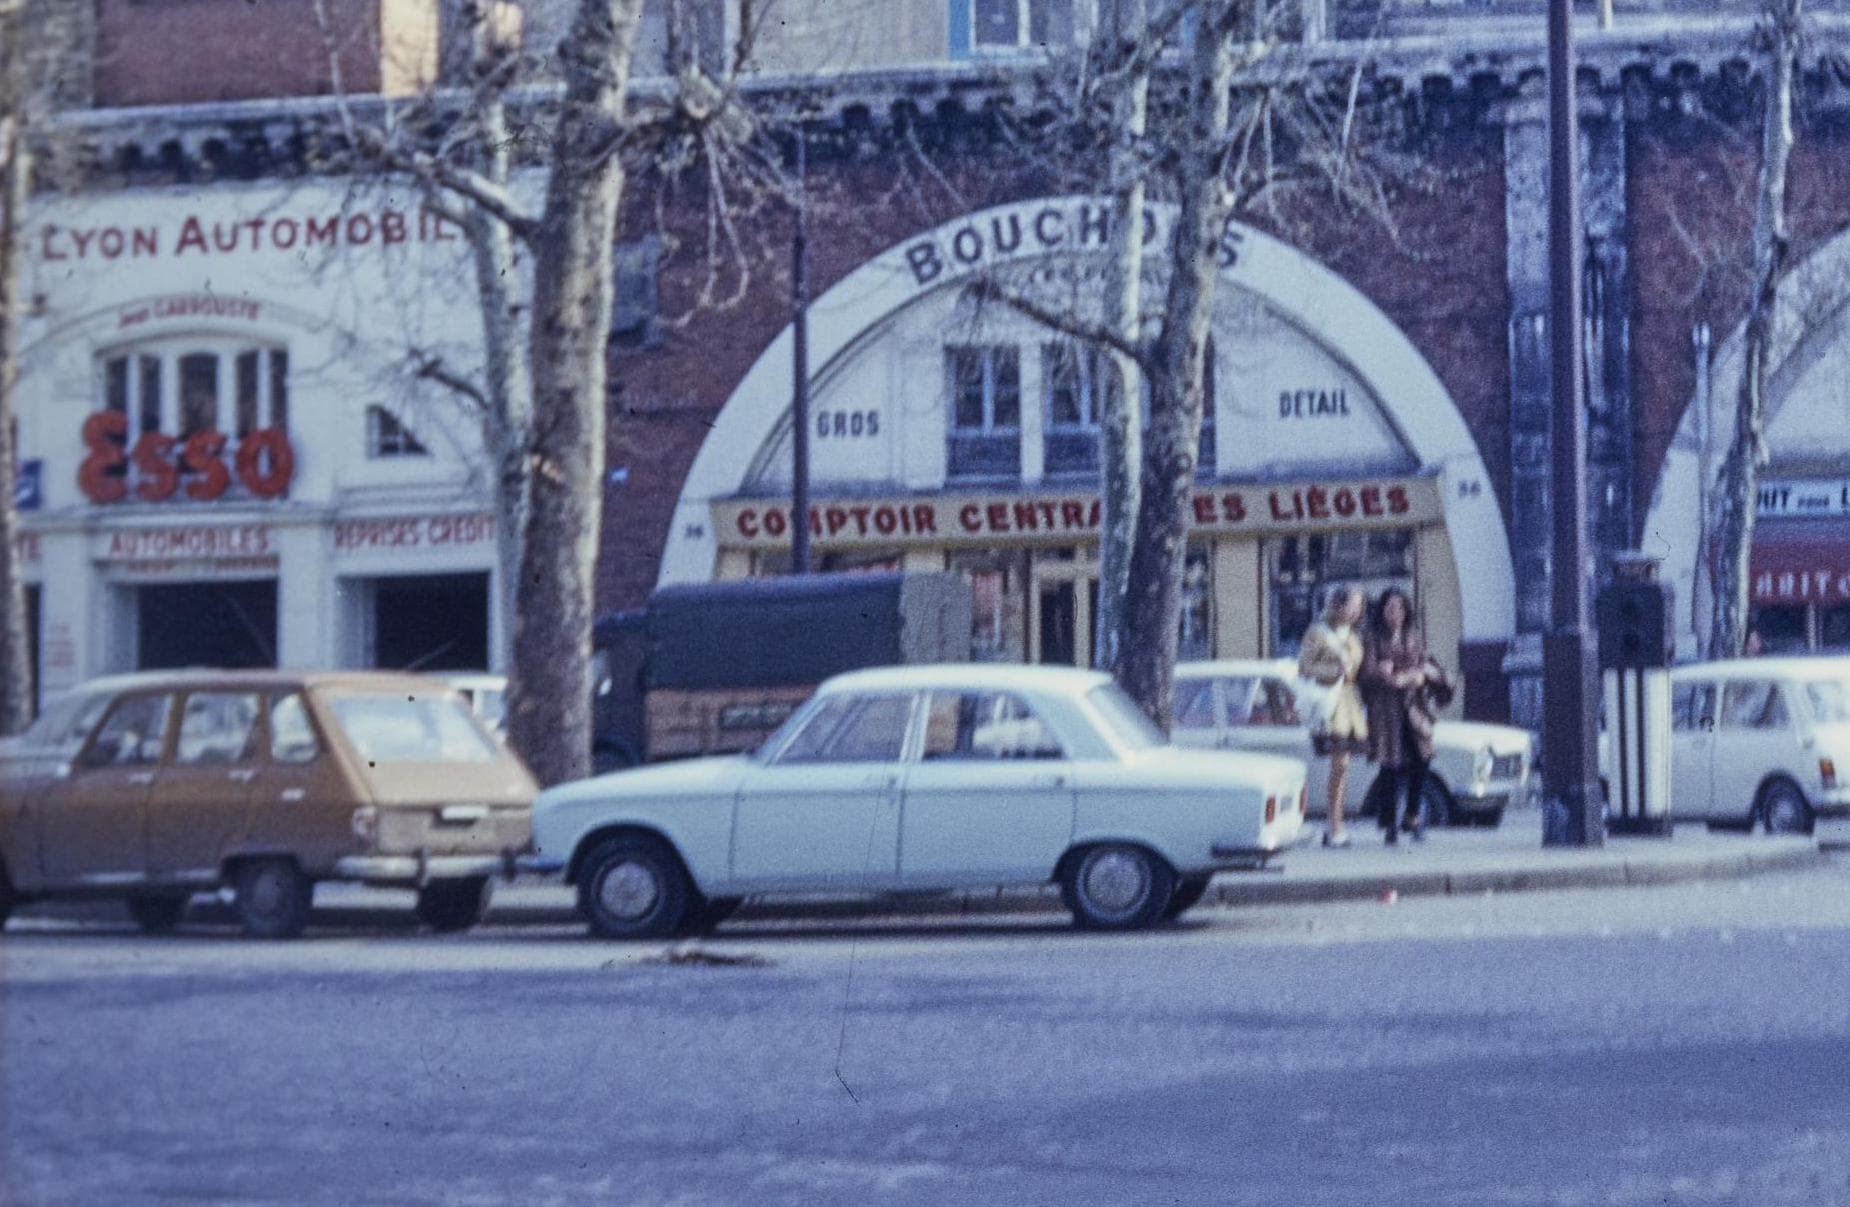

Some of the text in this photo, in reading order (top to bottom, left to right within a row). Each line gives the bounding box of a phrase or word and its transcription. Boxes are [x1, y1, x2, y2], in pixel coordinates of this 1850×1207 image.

[43, 205, 474, 260] LYON AUTOMOBIL
[905, 204, 1244, 285] BOUCHOS
[817, 410, 880, 438] GROS
[960, 499, 1101, 535] CENTRA
[1193, 491, 1247, 524] ES
[109, 523, 269, 555] AUTOMOBILES
